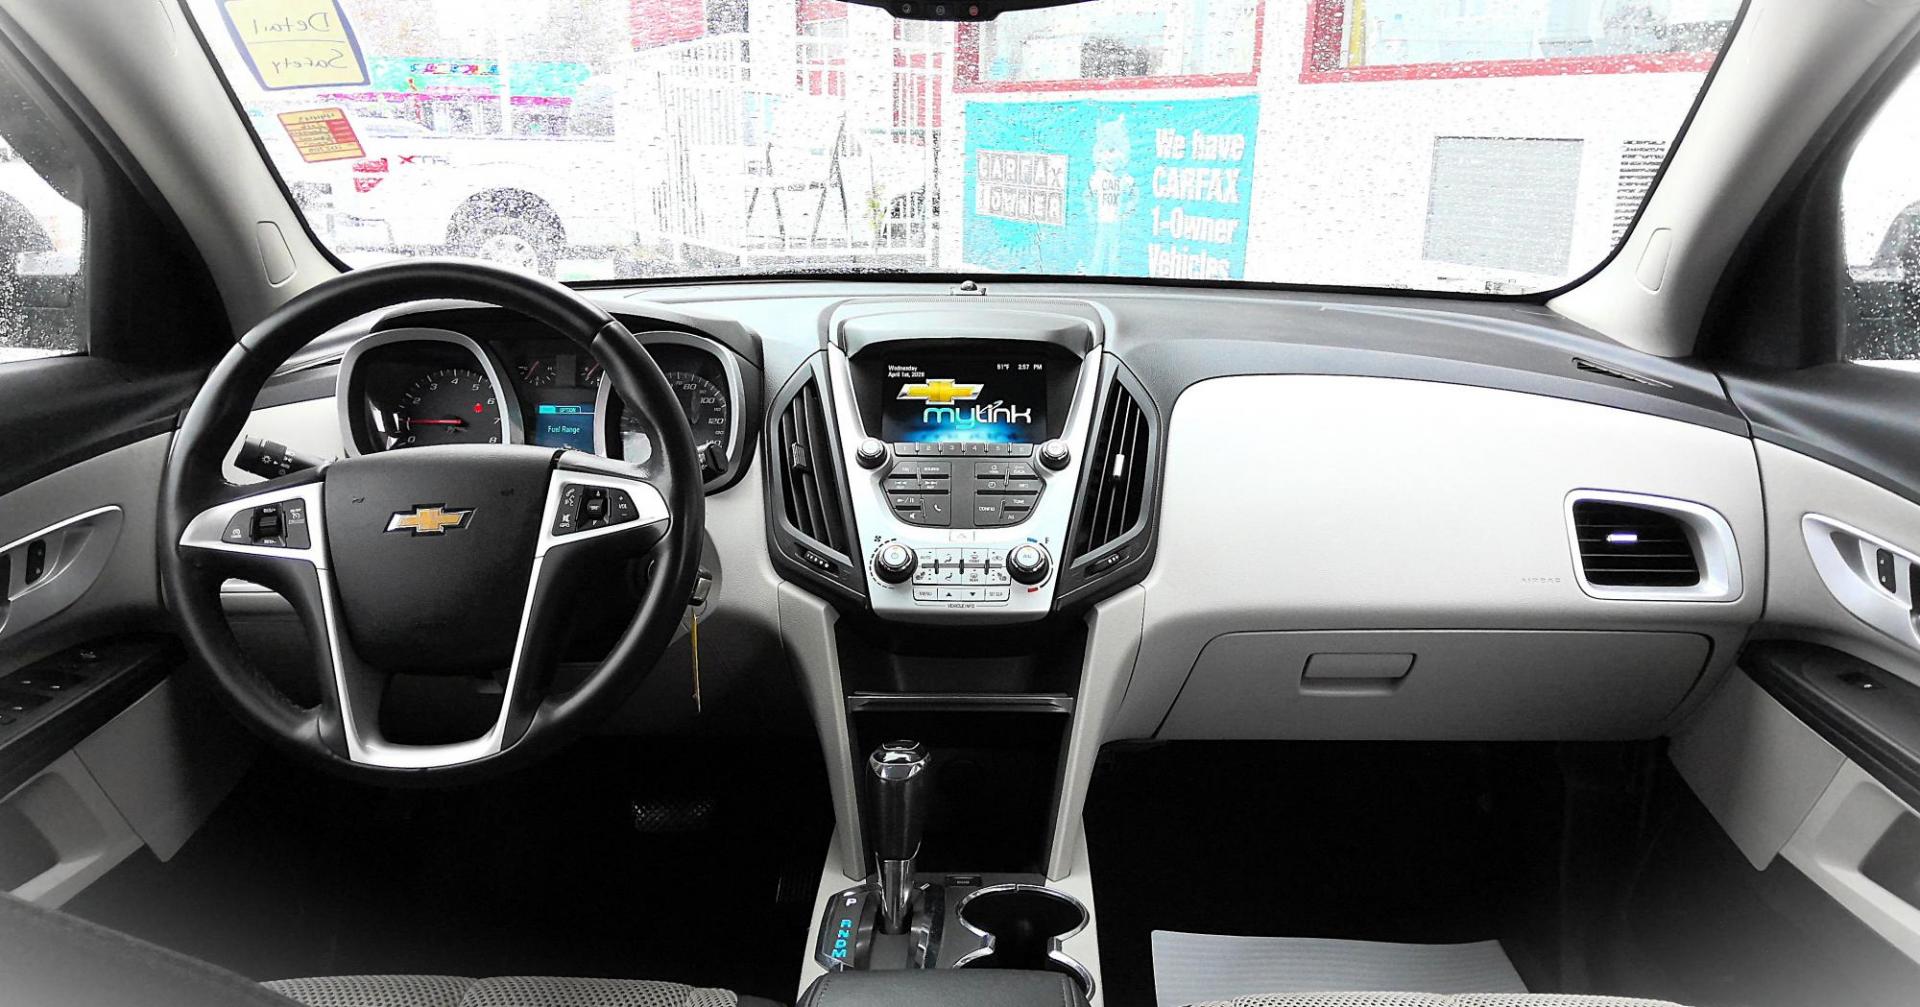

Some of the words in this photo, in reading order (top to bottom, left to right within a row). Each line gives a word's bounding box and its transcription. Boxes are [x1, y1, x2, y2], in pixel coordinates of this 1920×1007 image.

[1155, 128, 1186, 159] We
[1192, 129, 1246, 160] have
[977, 154, 1063, 188] CARFAX
[1101, 179, 1121, 191] CAR
[1152, 166, 1241, 203] CARFAX
[1102, 193, 1120, 207] FOX
[1151, 206, 1240, 244] 1-Owner
[888, 364, 918, 372] Wednesday
[450, 377, 459, 385] 4
[429, 382, 438, 391] 3
[471, 383, 480, 391] 5
[682, 383, 697, 391] 80
[412, 396, 421, 405] 2
[486, 397, 495, 405] 6
[700, 396, 716, 404] 100
[493, 416, 501, 425] 7
[547, 425, 561, 433] Fuel
[561, 425, 581, 435] Range
[407, 435, 416, 444] 0
[488, 436, 498, 444] 8
[845, 897, 857, 906] P
[831, 948, 847, 958] M
